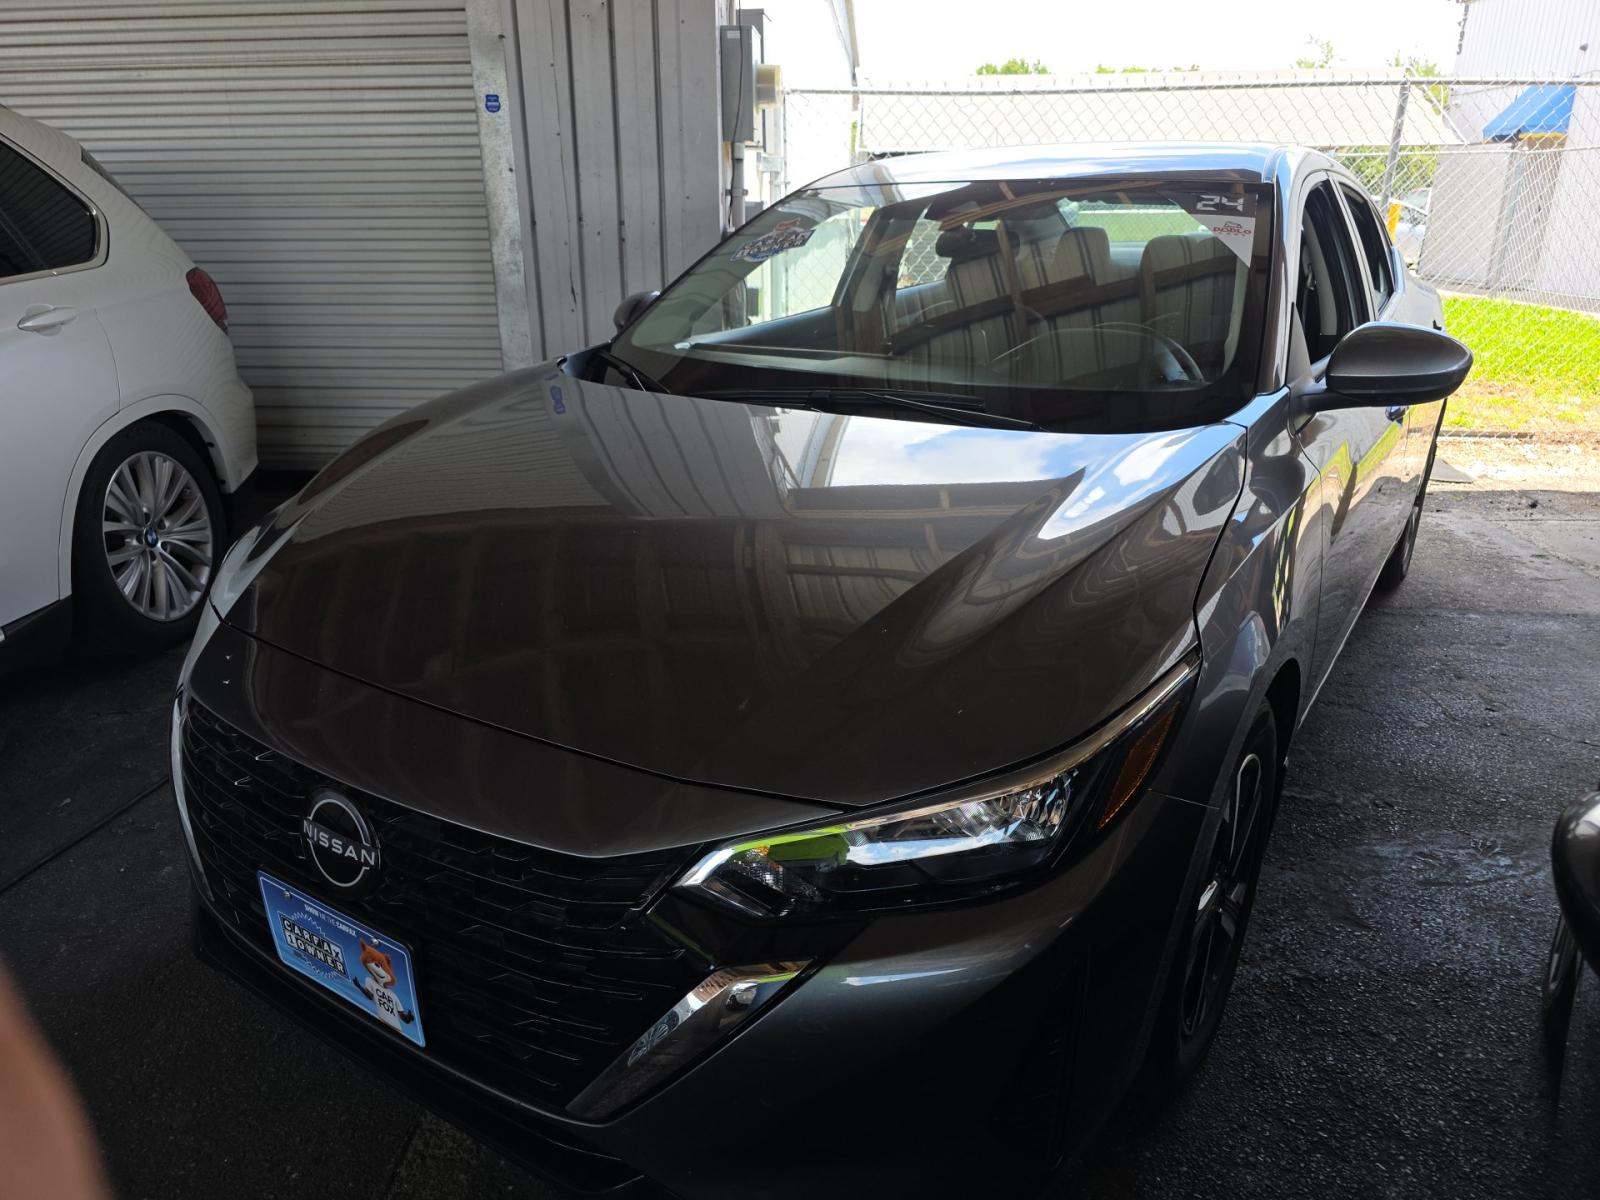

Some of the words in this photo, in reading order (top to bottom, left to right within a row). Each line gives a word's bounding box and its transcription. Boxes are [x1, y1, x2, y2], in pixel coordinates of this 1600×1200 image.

[1196, 194, 1244, 212] 24
[303, 819, 375, 866] NISSAN
[282, 917, 344, 959] CARFAX
[375, 988, 394, 1004] CAR
[378, 999, 396, 1017] FOX
